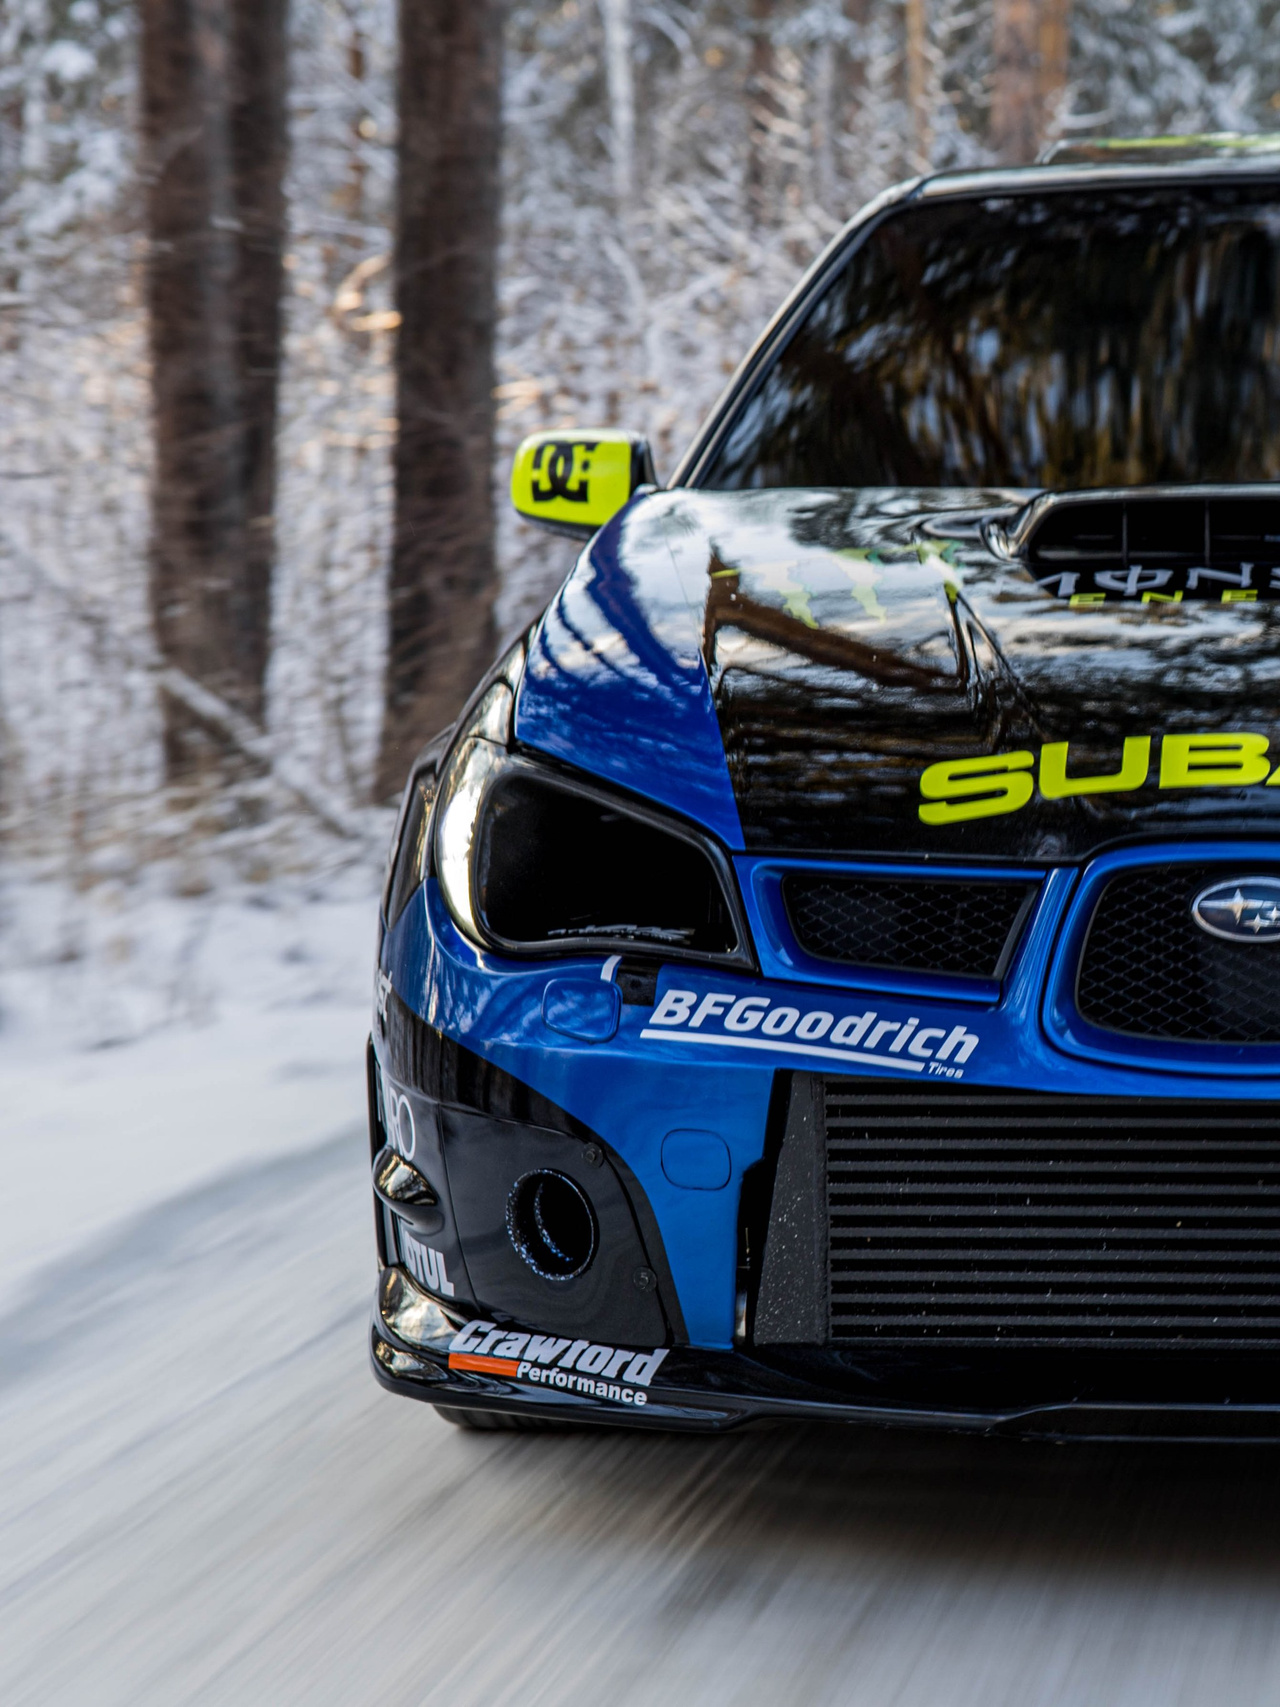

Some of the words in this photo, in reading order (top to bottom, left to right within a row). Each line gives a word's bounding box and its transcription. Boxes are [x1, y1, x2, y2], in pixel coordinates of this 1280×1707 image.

[649, 989, 980, 1064] BFGoodrich
[928, 1061, 965, 1080] Tires
[449, 1319, 670, 1387] Crawford
[516, 1361, 648, 1407] Performance
